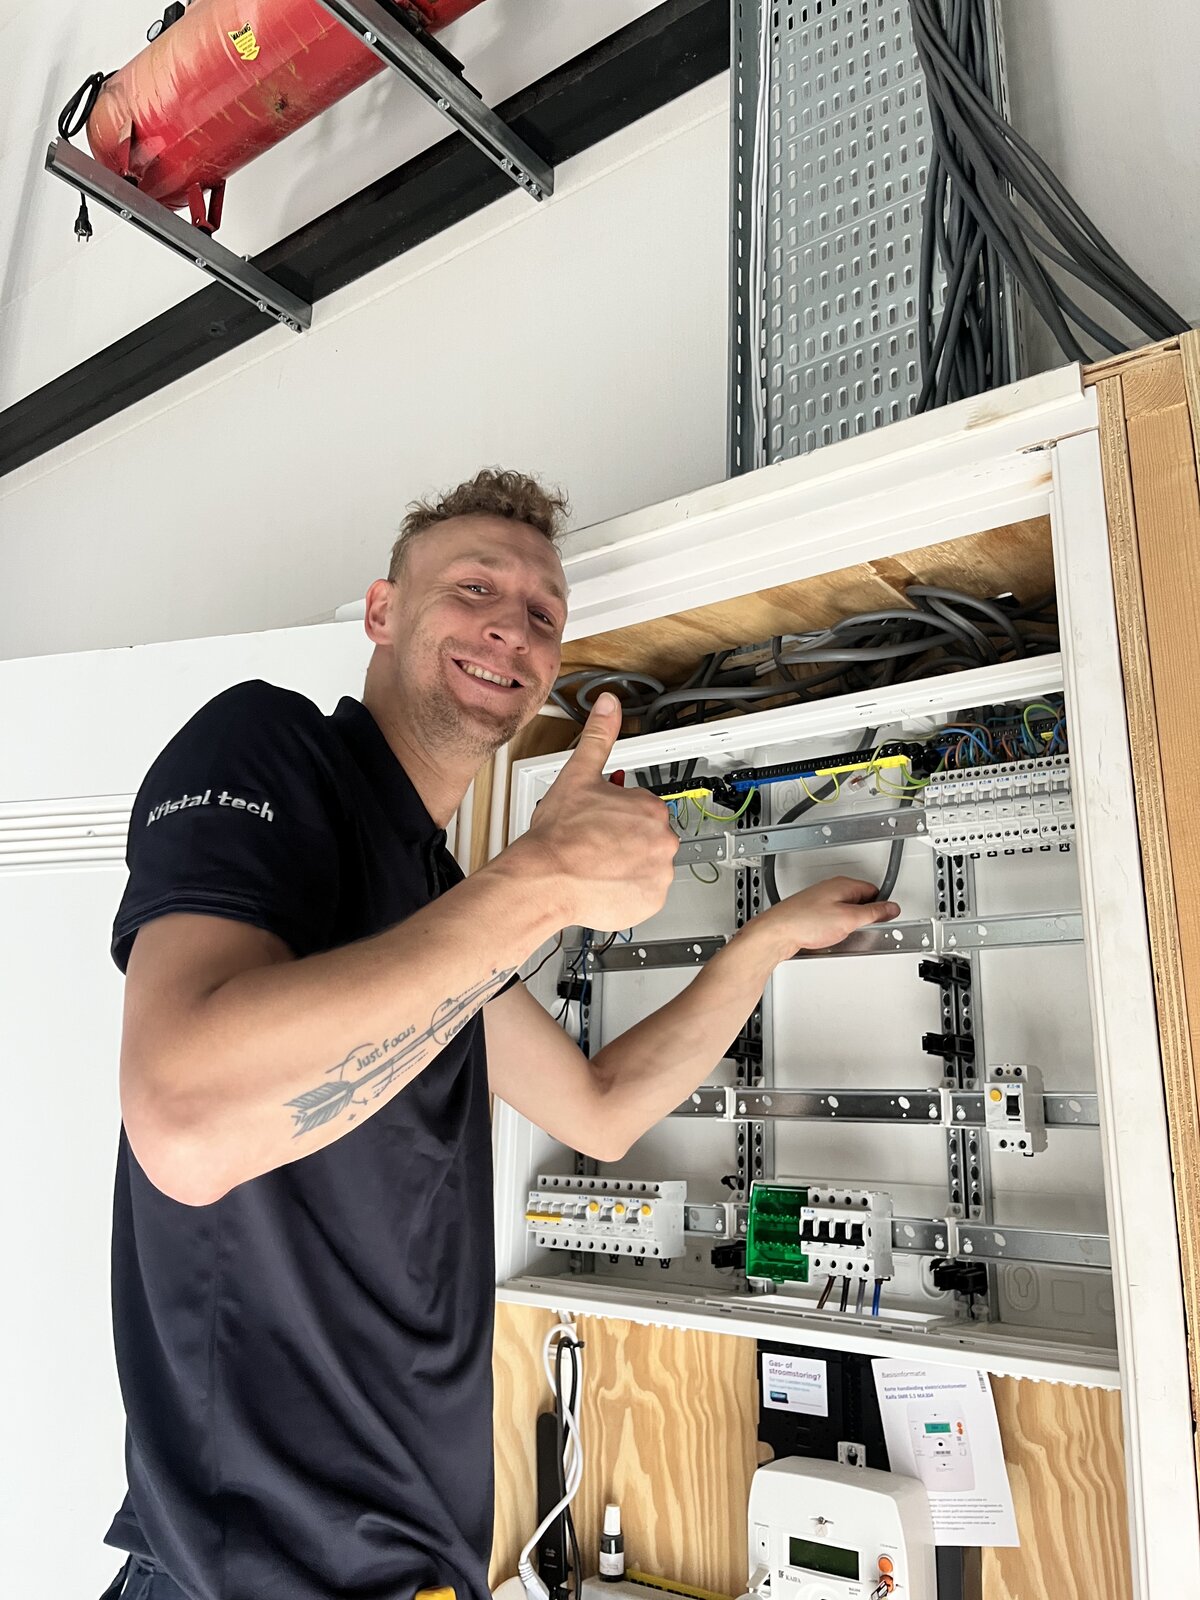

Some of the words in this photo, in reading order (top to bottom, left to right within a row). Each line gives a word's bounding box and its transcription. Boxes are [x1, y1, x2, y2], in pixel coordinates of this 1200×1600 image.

[217, 791, 274, 822] tech
[356, 1047, 383, 1071] Just
[382, 1024, 417, 1053] Focus
